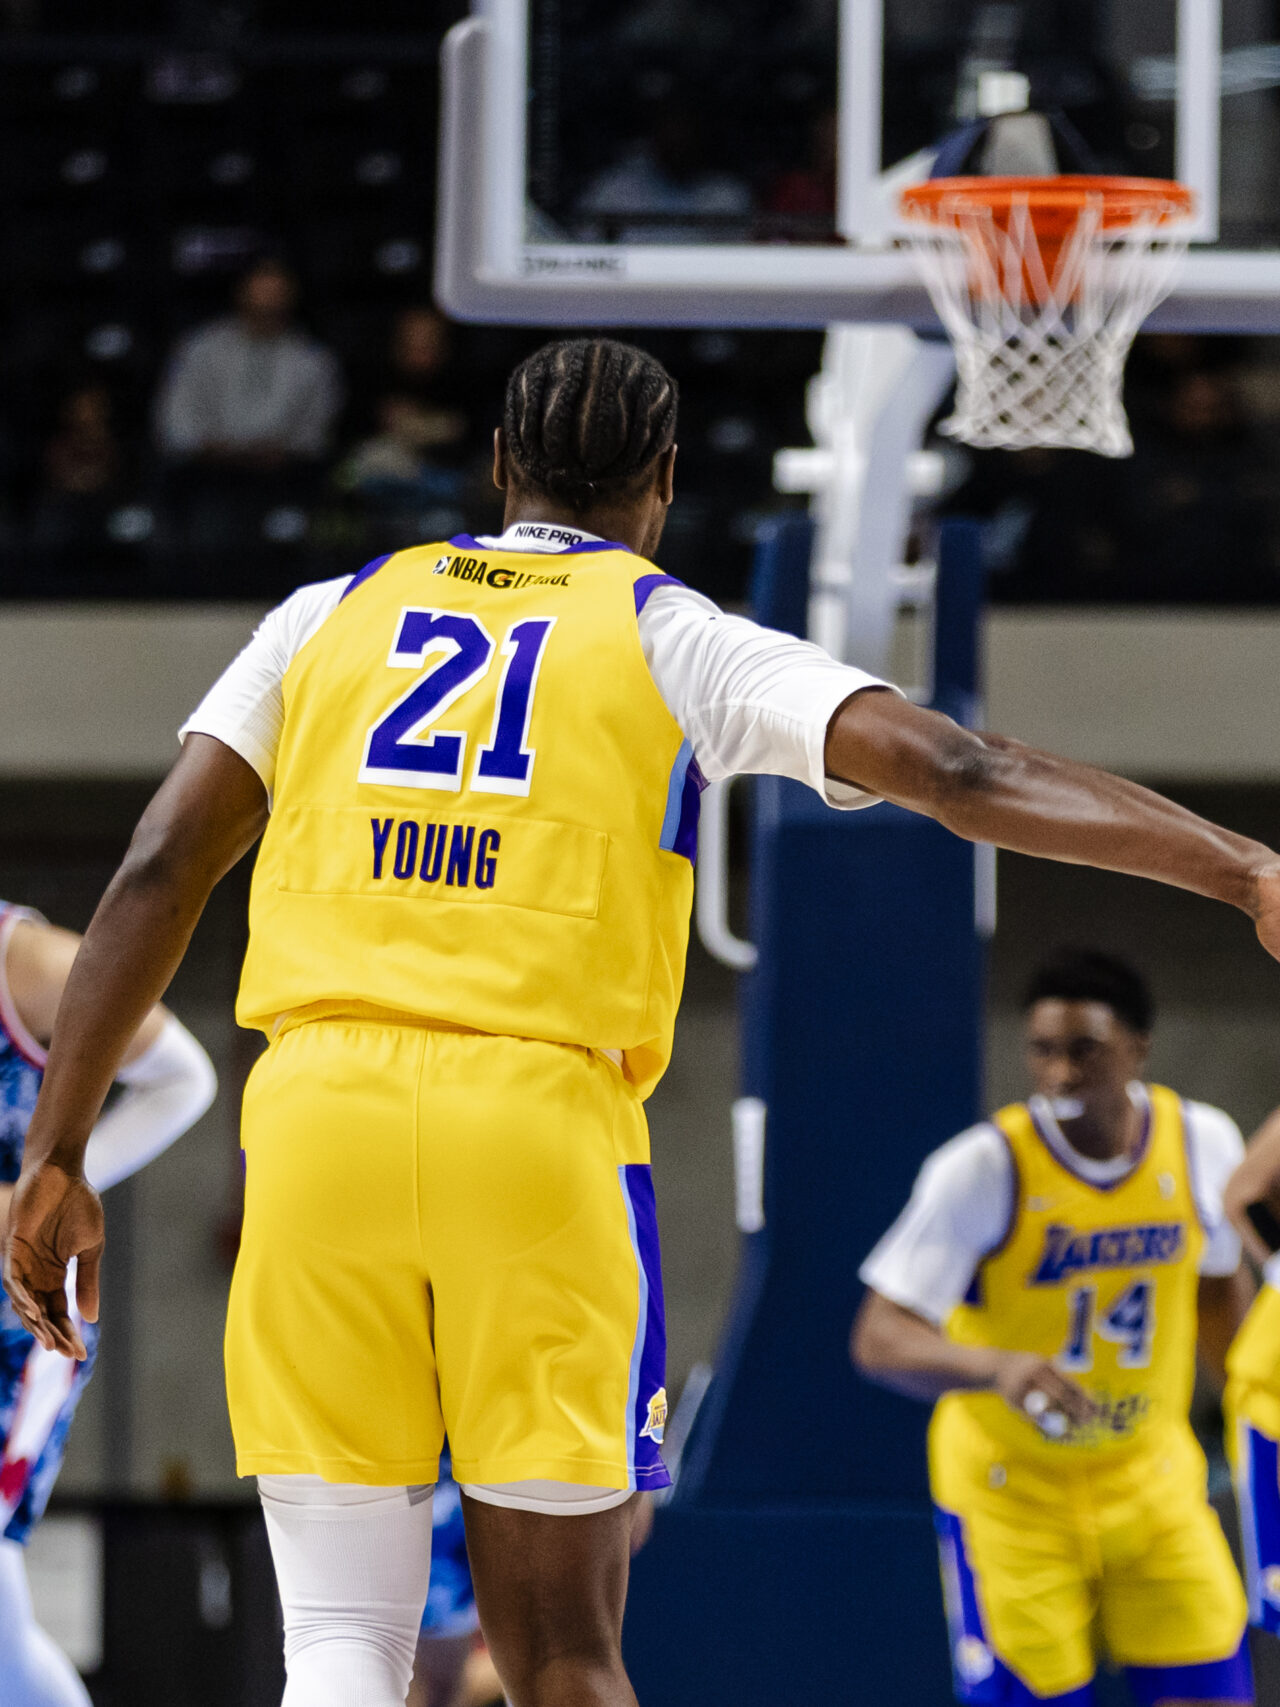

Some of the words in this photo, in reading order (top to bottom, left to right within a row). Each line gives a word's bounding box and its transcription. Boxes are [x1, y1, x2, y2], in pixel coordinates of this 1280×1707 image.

[447, 556, 488, 585] NBA
[514, 525, 549, 540] NIKE
[548, 529, 583, 546] PRO
[357, 606, 558, 797] 21
[370, 818, 502, 890] YOUNG
[1053, 1277, 1157, 1374] 14
